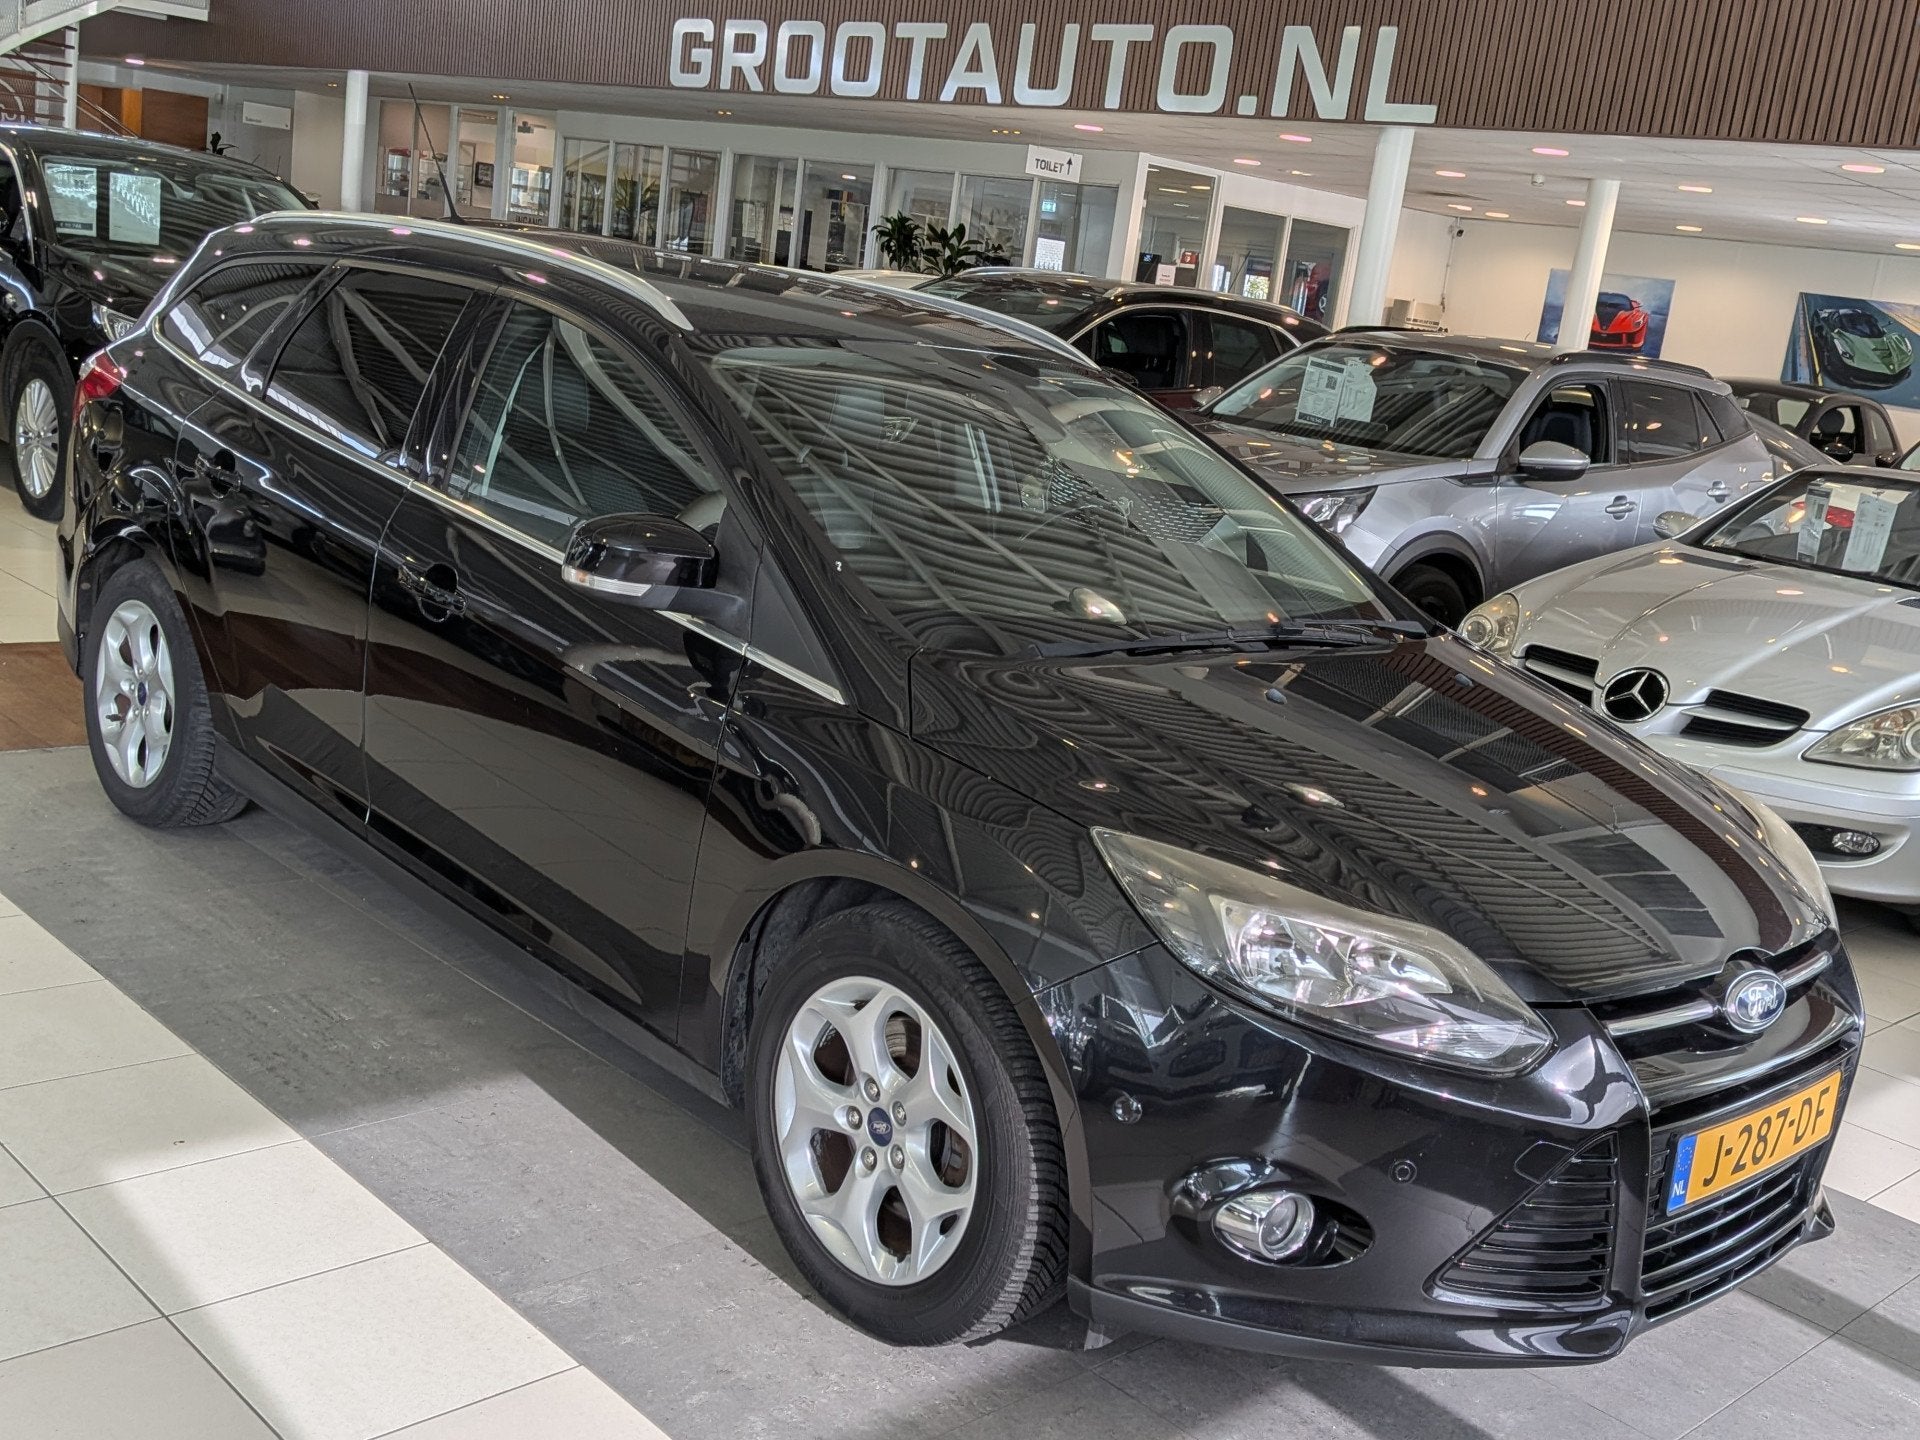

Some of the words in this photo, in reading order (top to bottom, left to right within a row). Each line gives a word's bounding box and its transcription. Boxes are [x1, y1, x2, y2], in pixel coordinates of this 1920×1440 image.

[670, 18, 1437, 124] GROOTAUTO.NL
[1034, 158, 1064, 173] TOILET
[1747, 981, 1779, 1019] Ford
[1702, 1086, 1831, 1188] J-287-DF
[1671, 1180, 1685, 1198] NL
